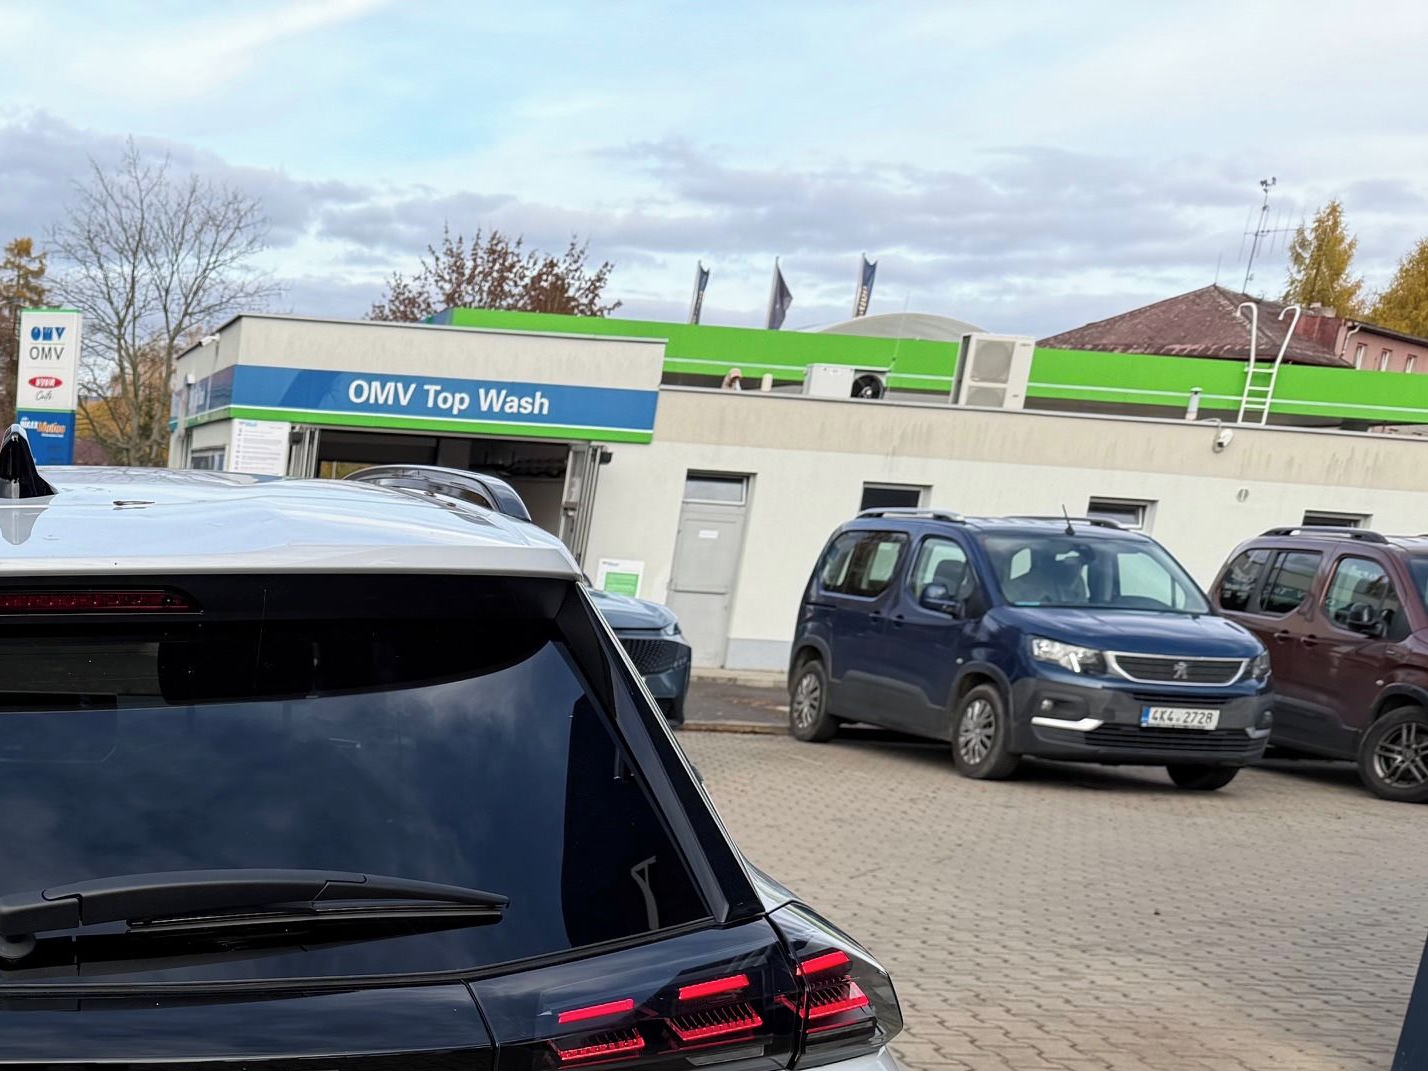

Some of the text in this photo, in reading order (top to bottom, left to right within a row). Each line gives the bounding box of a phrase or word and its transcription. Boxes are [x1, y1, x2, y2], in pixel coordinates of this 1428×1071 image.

[31, 326, 65, 341] OMV
[29, 346, 64, 361] OMV
[348, 380, 550, 415] OMV Top Wash
